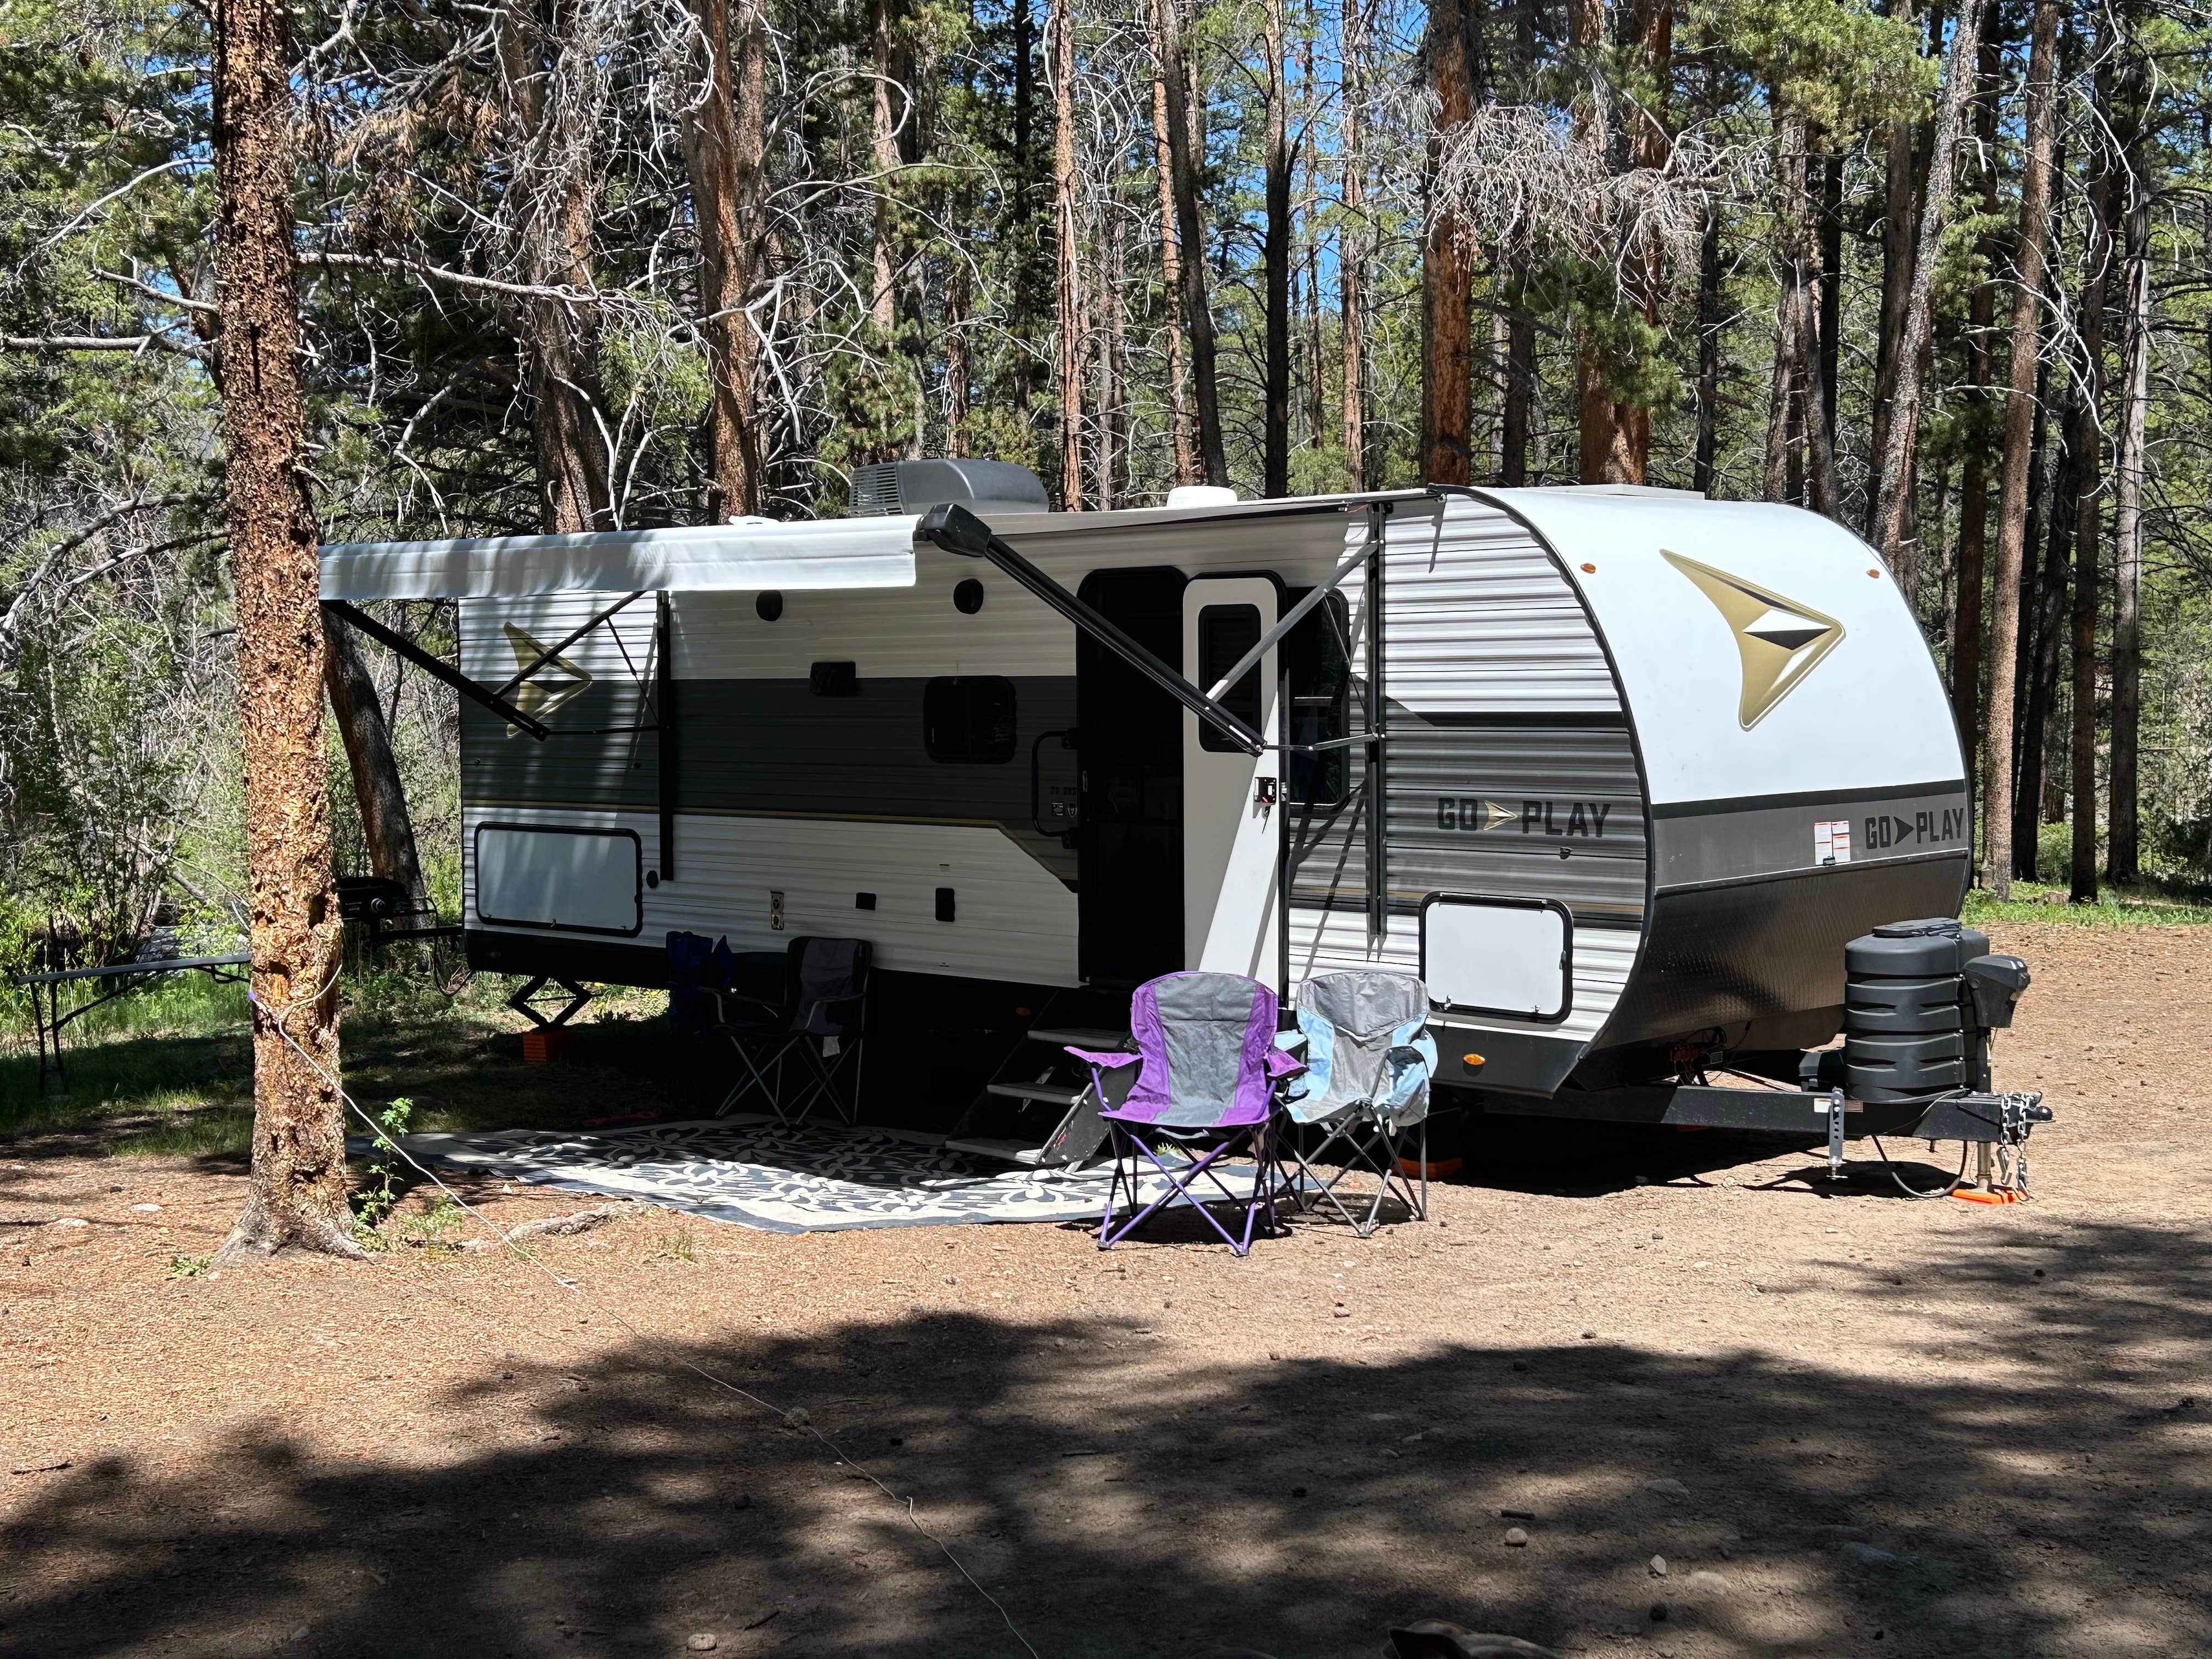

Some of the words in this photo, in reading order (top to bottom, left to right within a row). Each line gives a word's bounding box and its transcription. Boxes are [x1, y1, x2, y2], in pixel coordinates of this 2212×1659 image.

[1437, 797, 1477, 831] GO
[1522, 801, 1611, 838] PLAY
[1865, 816, 1891, 849] GO
[1916, 808, 1964, 844] PLAY
